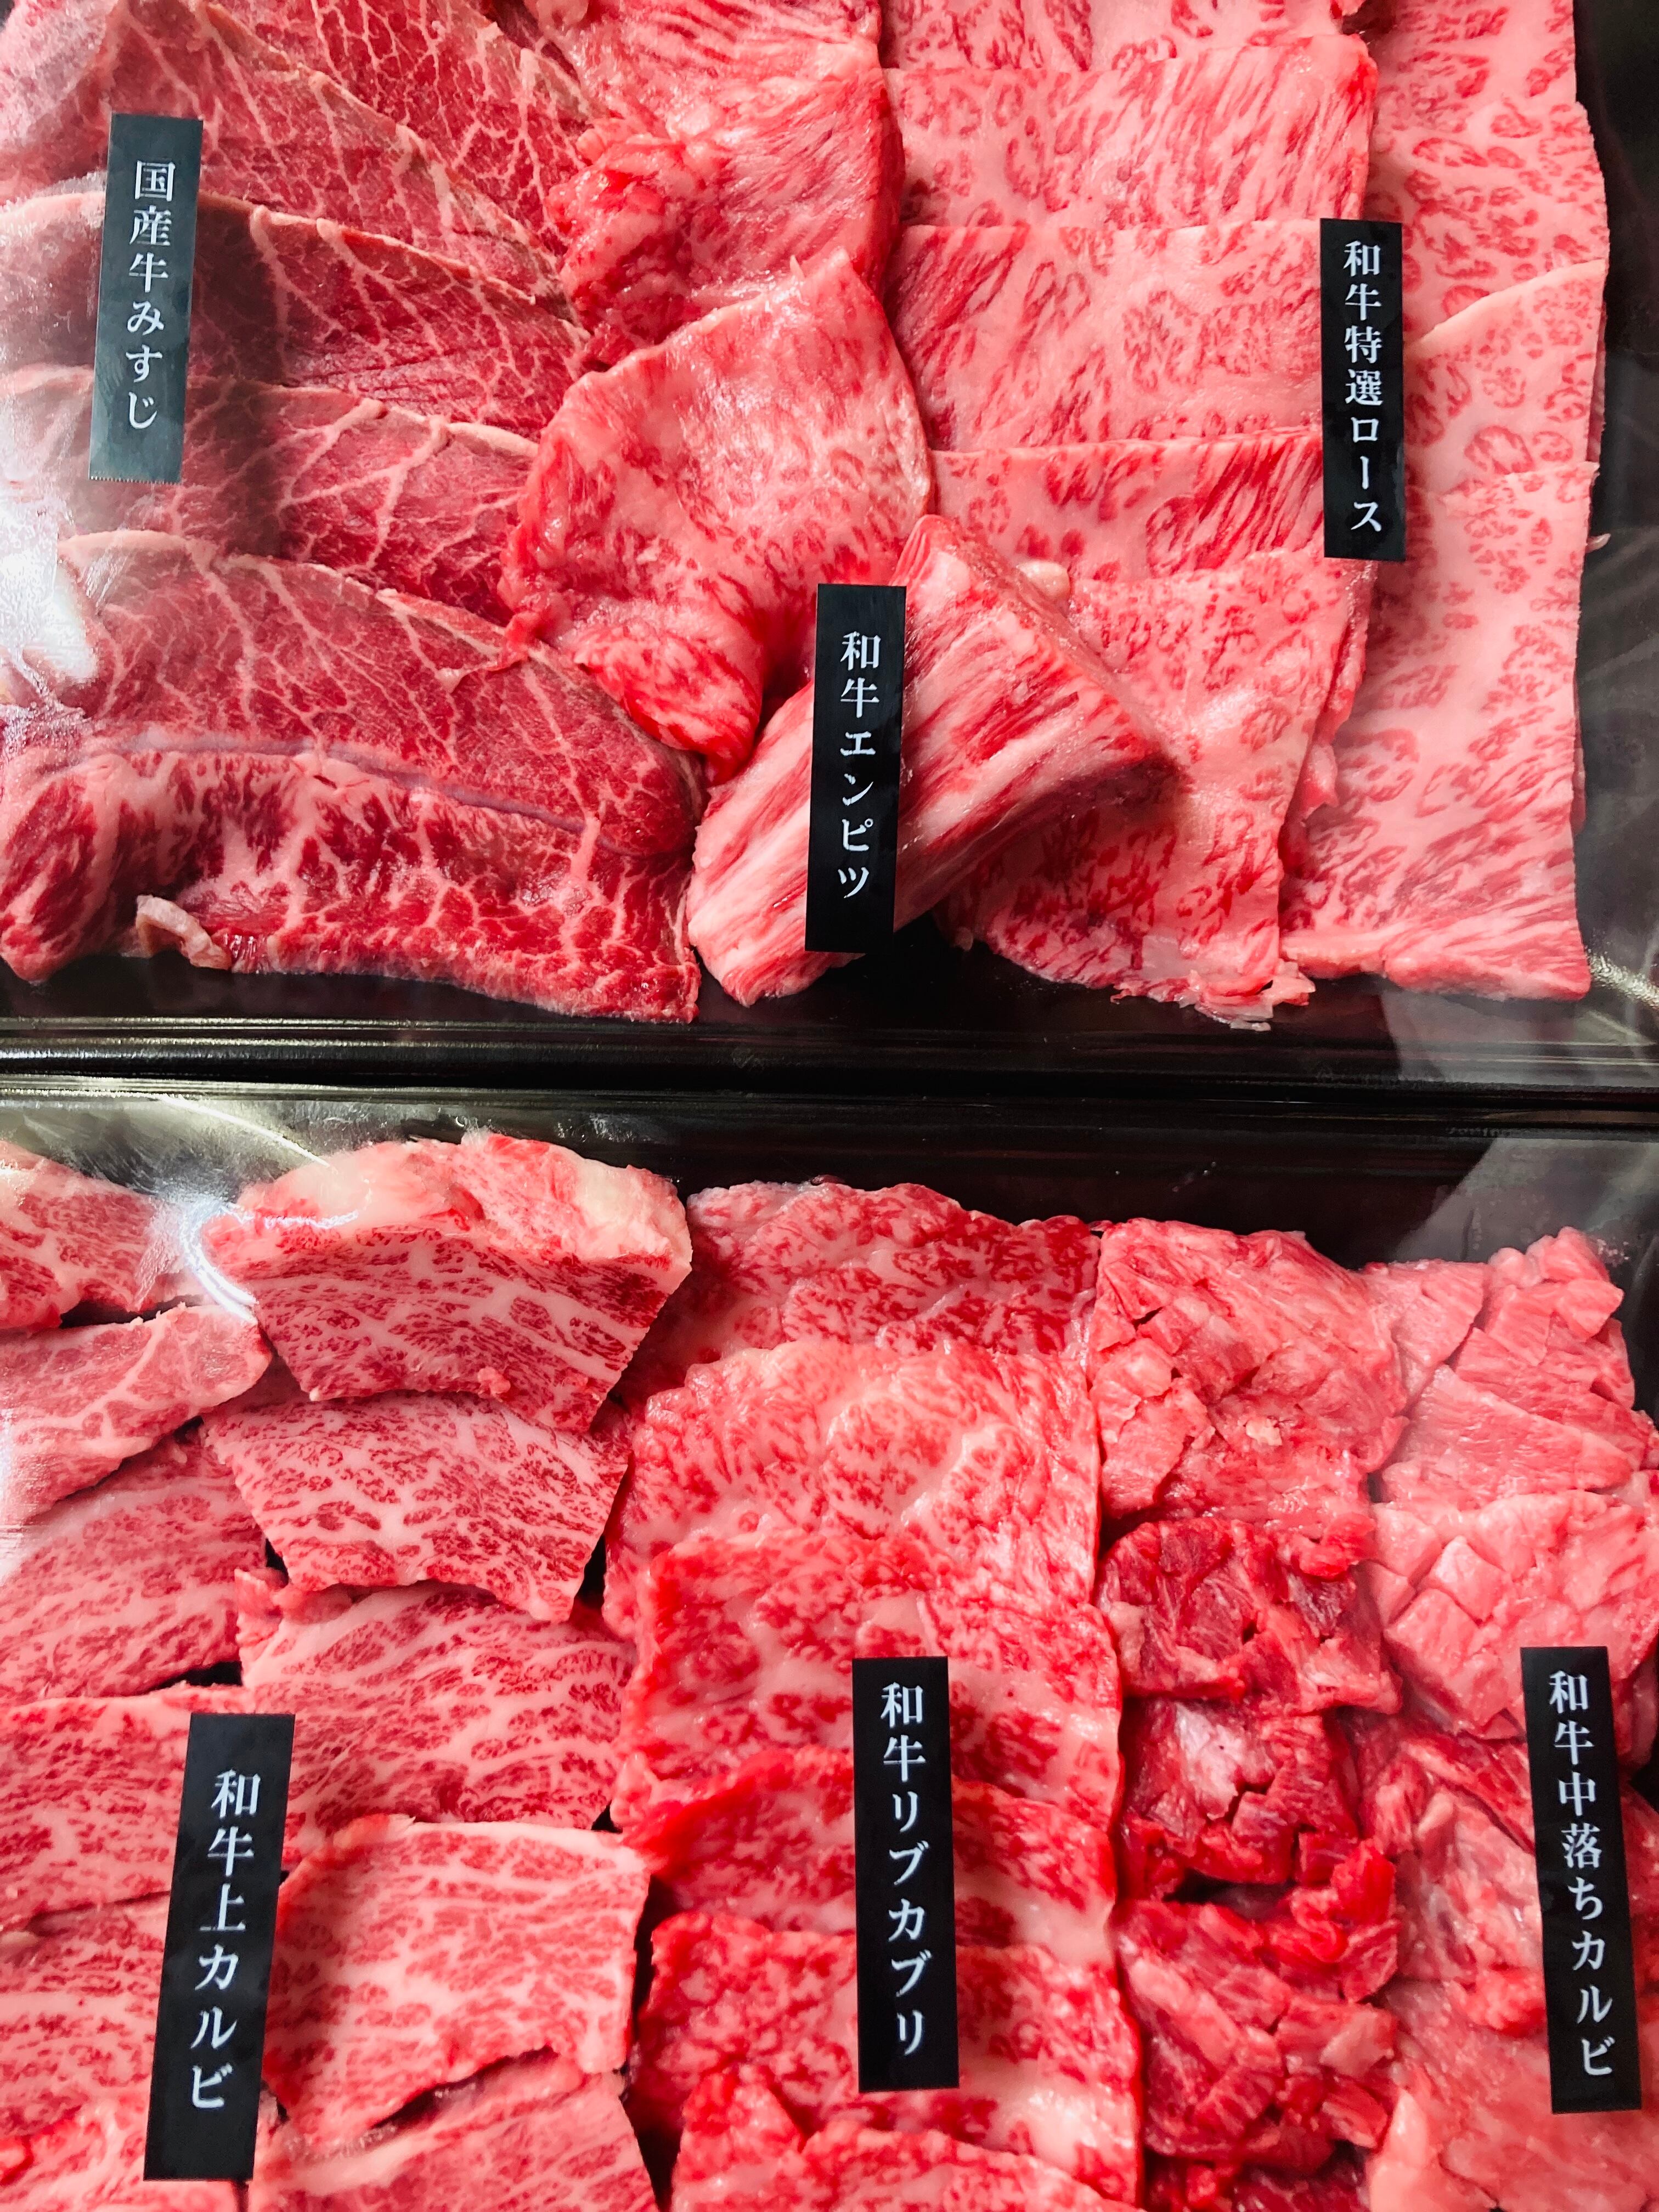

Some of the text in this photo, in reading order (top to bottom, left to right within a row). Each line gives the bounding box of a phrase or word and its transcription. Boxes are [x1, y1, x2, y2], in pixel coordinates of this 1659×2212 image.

[126, 160, 175, 429] 国産牛みすじ
[1343, 240, 1383, 532] 和牛特選ロース
[838, 631, 881, 899] 和牛エンピツ
[189, 1769, 261, 2109] 和牛上カルビ
[881, 1682, 932, 2055] 和牛リブカブリ
[1548, 1671, 1615, 2076] 和牛中落ちカルビ
